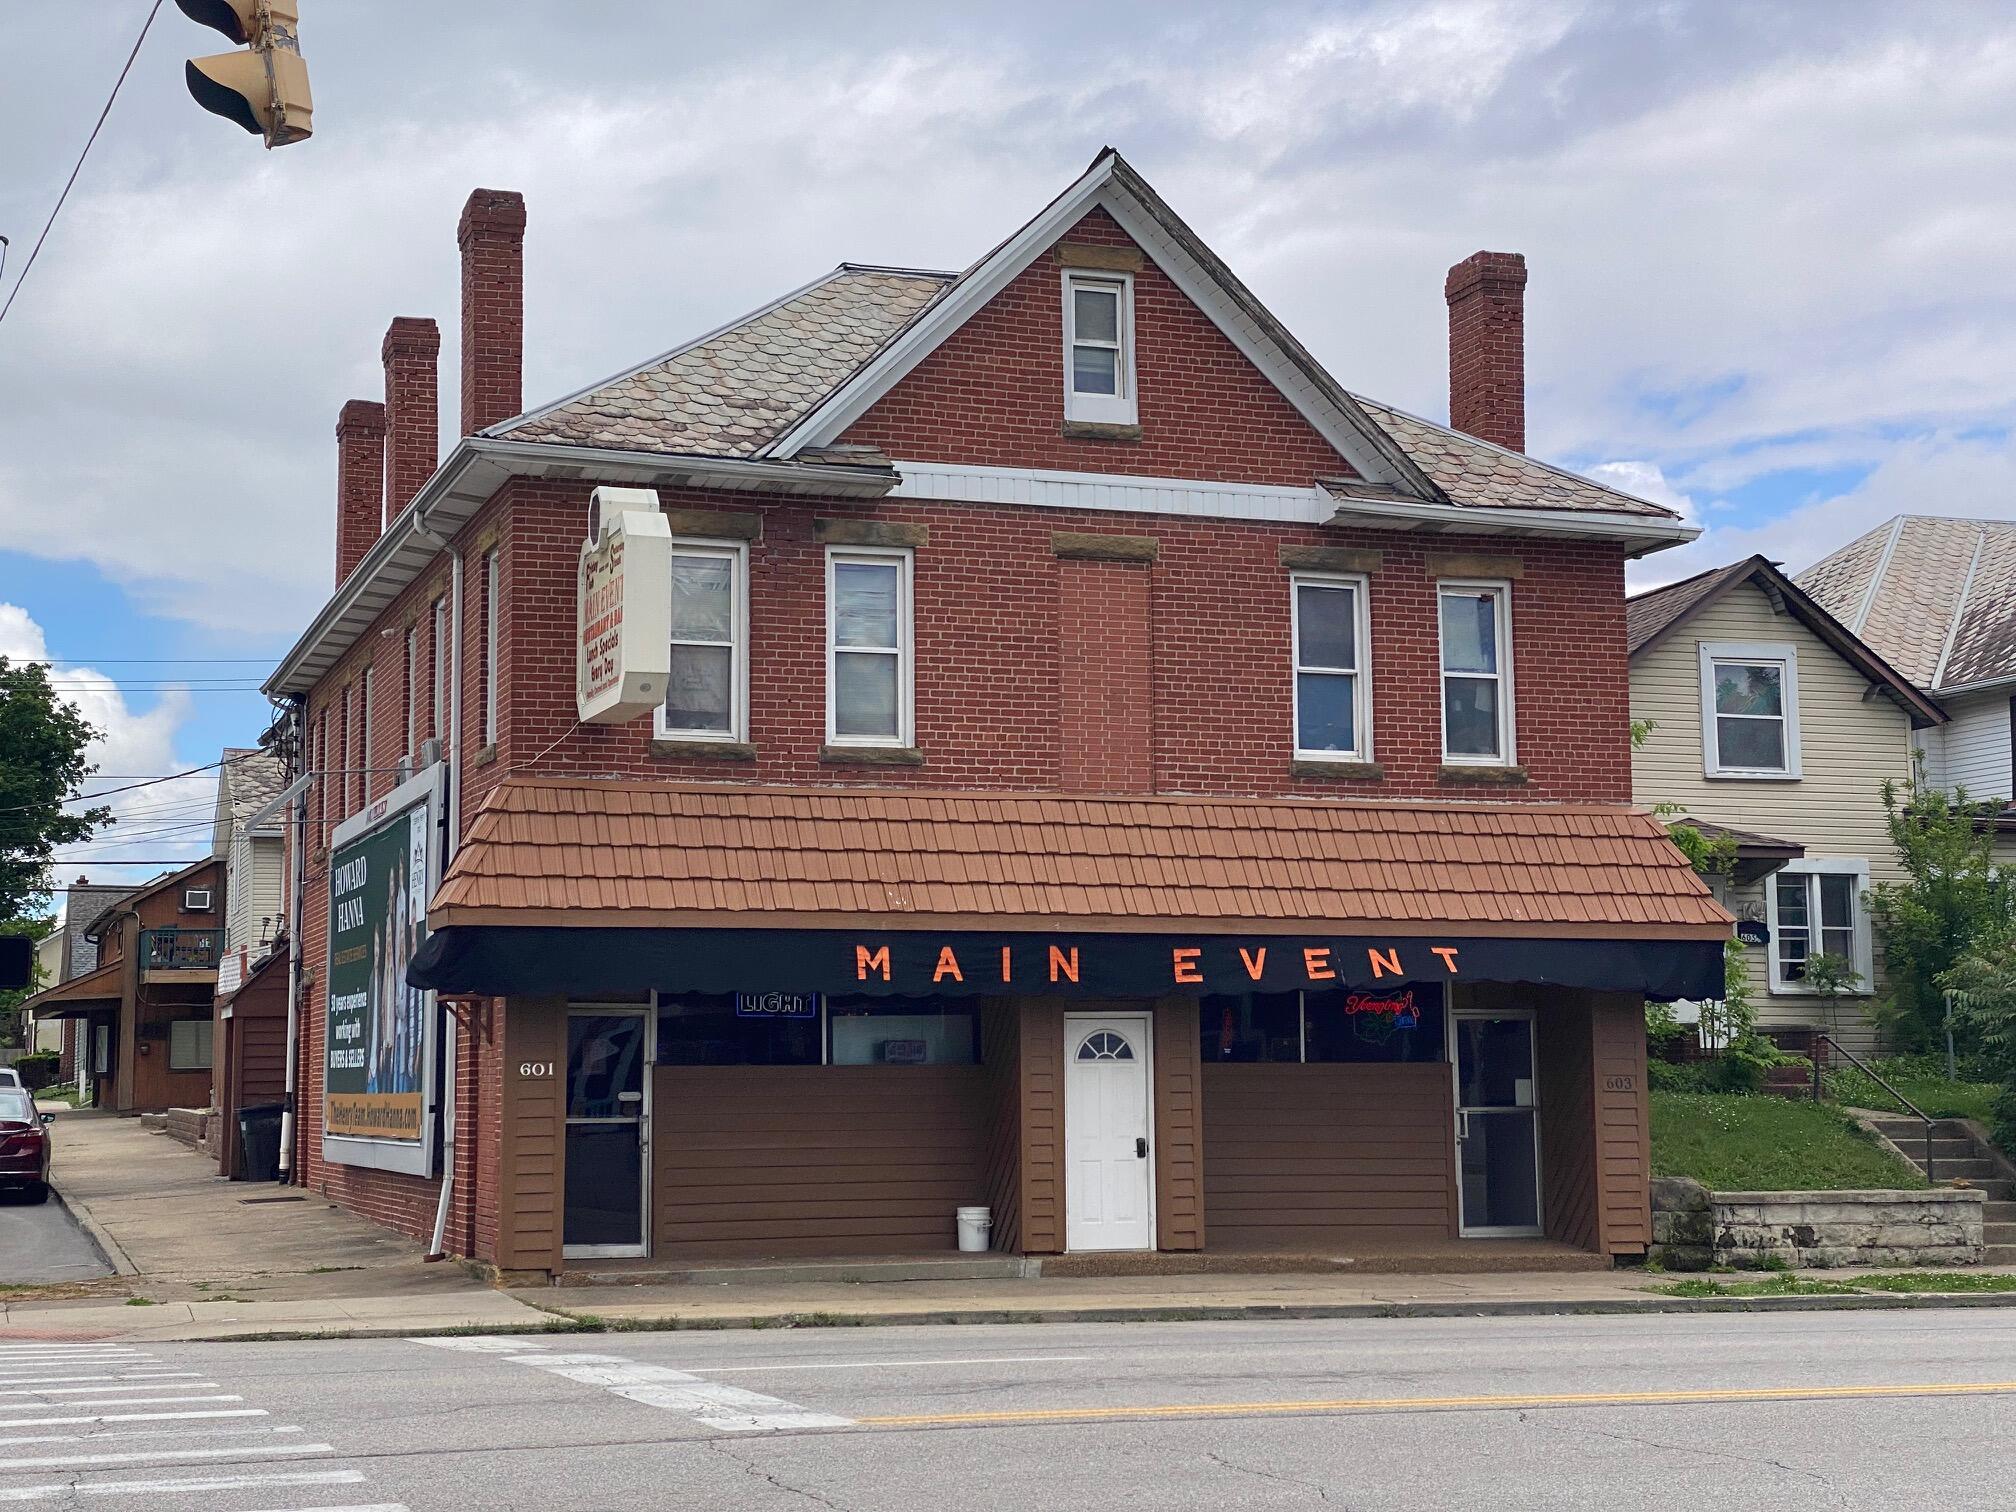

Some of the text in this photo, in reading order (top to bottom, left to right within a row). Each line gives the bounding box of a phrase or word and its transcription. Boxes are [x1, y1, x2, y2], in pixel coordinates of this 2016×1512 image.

[600, 575, 623, 614] EVENT
[586, 630, 618, 663] Lunch Specials
[591, 657, 614, 682] Every Day
[335, 856, 367, 897] HOWARD
[338, 896, 364, 933] HANNA
[857, 945, 1458, 983] MAIN EVENT
[335, 996, 346, 1016] years
[346, 987, 367, 1014] experience
[741, 991, 811, 1012] LIGHT
[335, 1017, 361, 1044] working with
[330, 1049, 345, 1069] BUYERS
[348, 1048, 365, 1069] SELLERS
[519, 1063, 553, 1076] 601
[1606, 1077, 1632, 1090] 603
